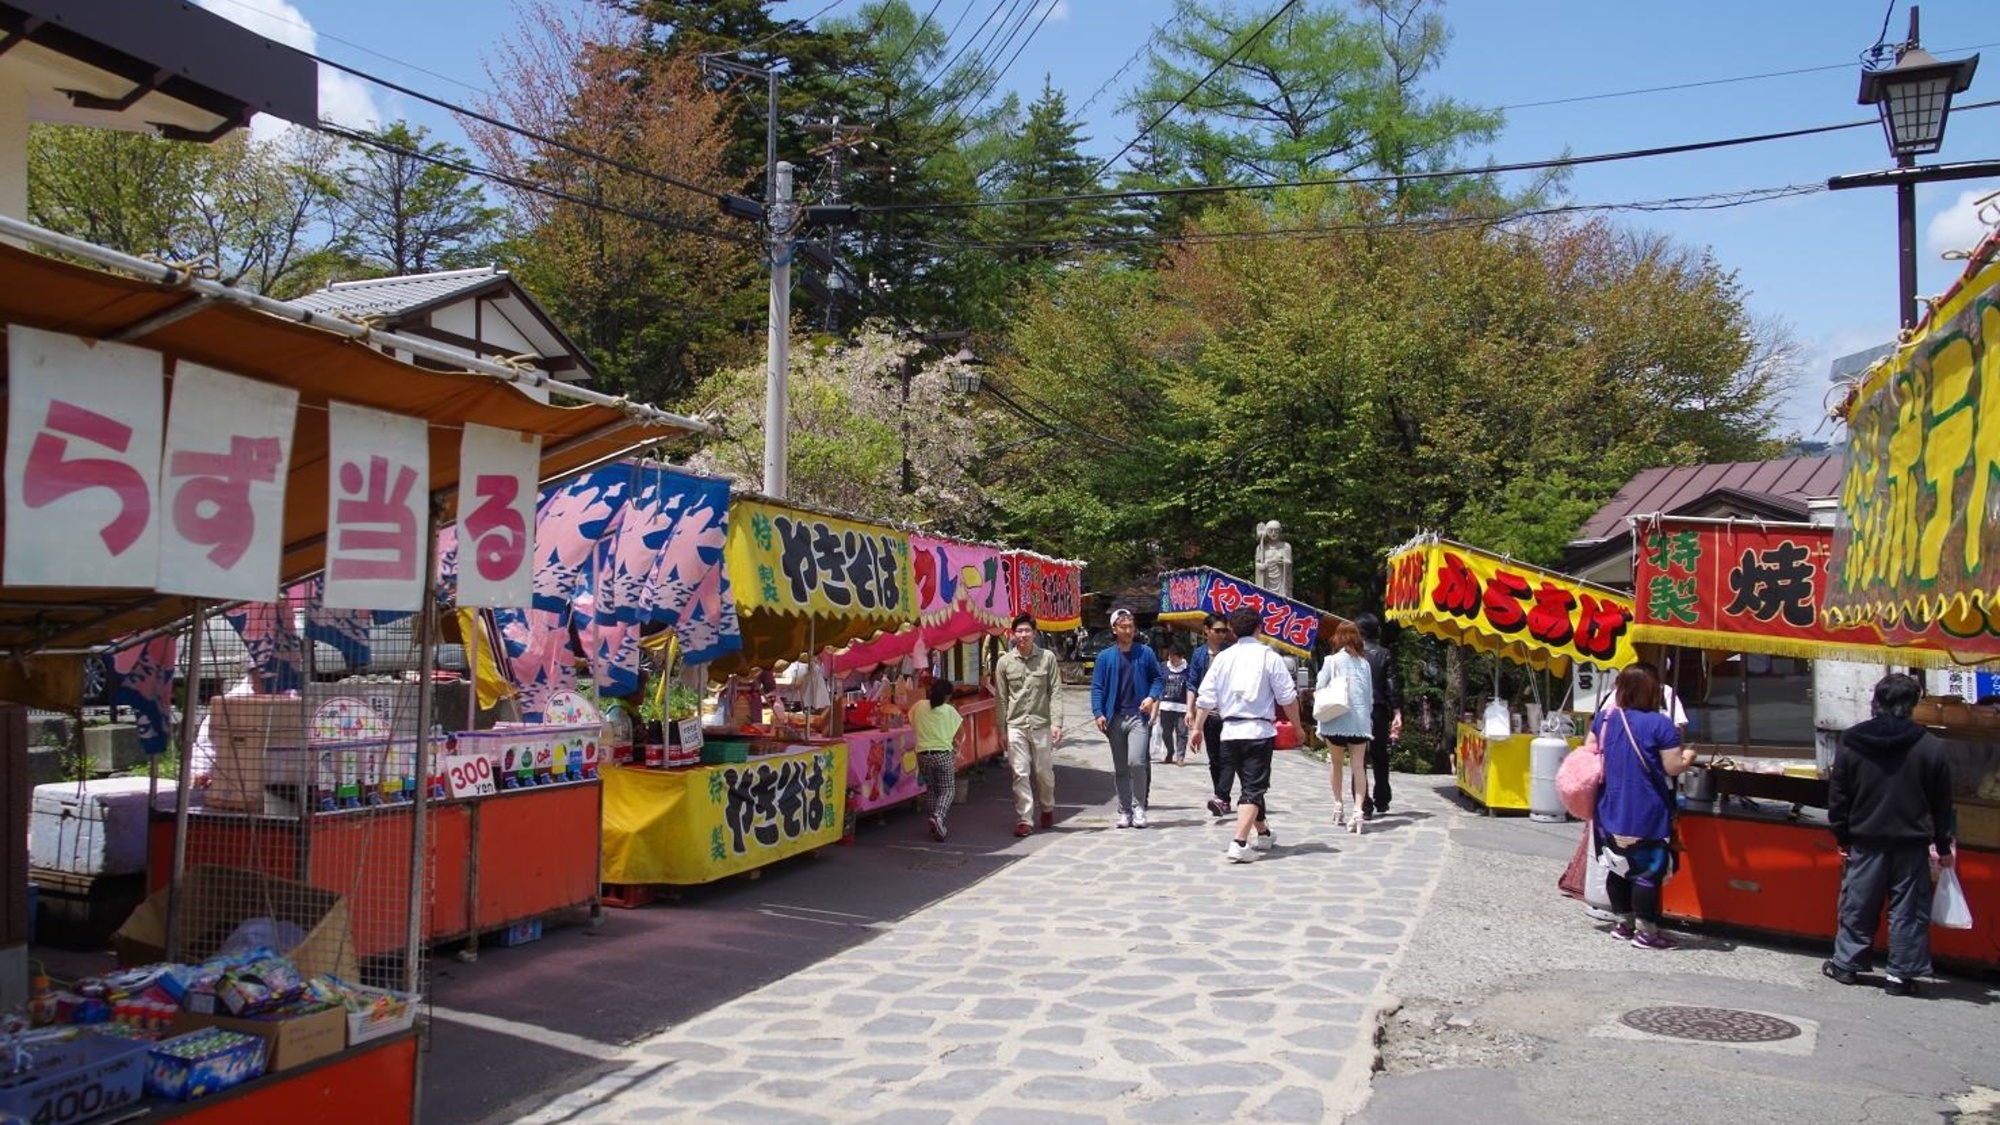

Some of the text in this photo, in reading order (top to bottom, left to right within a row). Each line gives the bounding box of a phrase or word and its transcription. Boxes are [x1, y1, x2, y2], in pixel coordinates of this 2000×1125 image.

[774, 515, 900, 611] やきそば
[1431, 552, 1633, 661] からあげ
[1648, 529, 1702, 624] 特製
[1209, 577, 1319, 647] やきそば
[451, 756, 490, 790] 300
[475, 782, 494, 795] yen
[723, 753, 826, 855] やきそば
